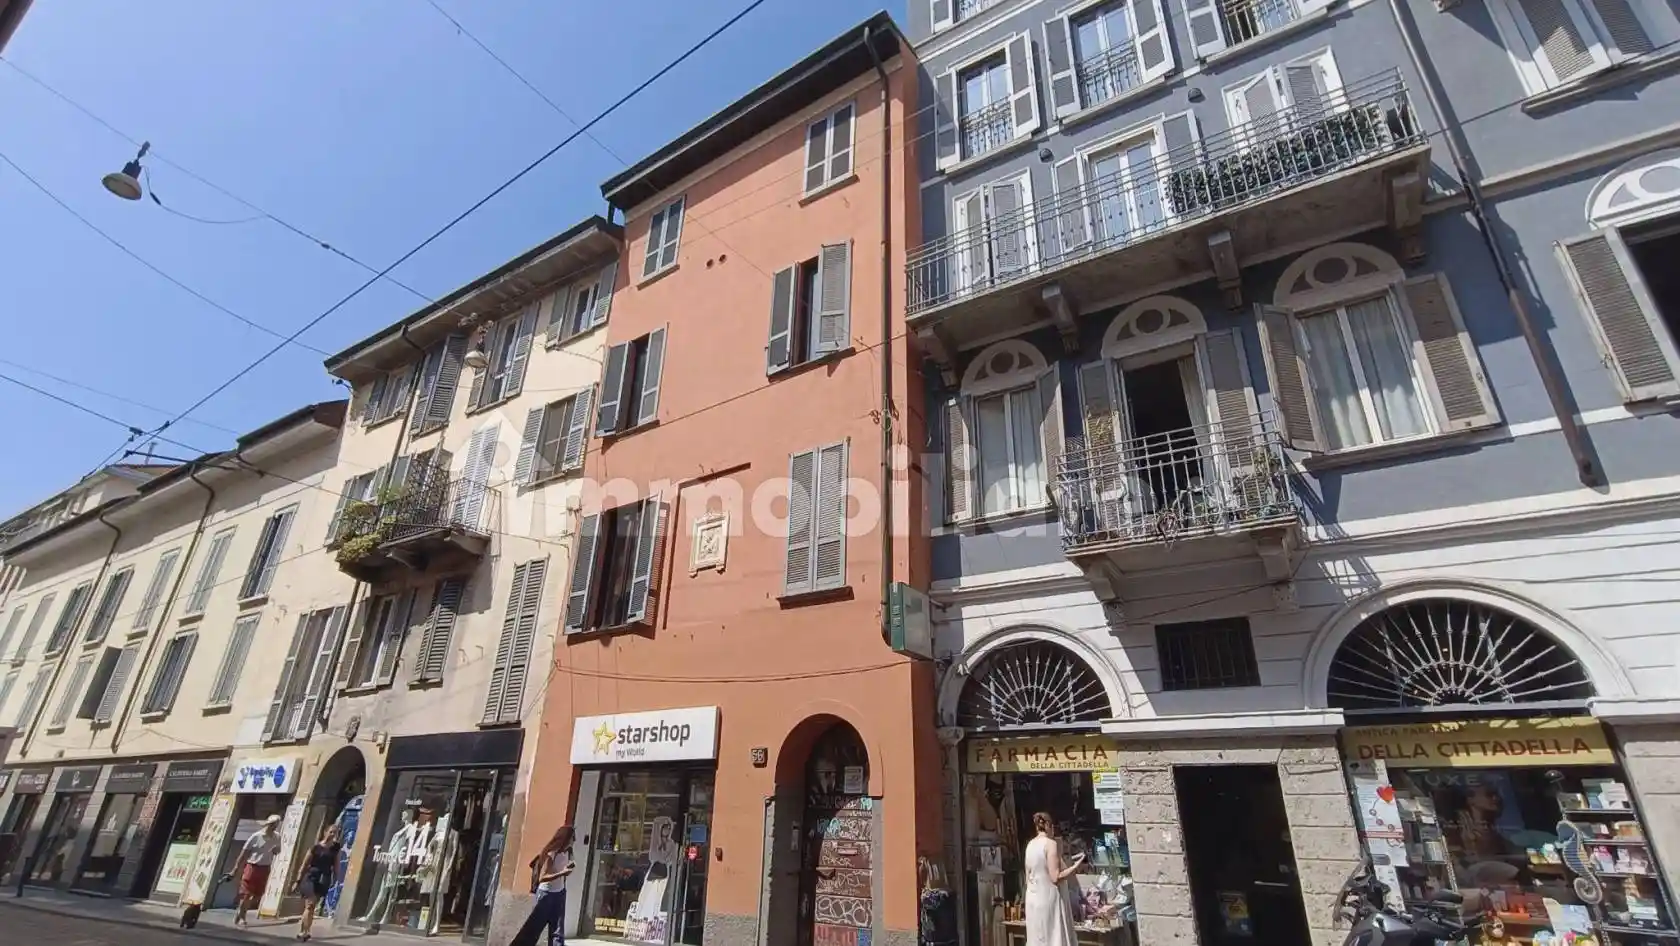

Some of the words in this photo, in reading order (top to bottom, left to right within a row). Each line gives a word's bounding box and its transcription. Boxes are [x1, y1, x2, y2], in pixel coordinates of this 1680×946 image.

[617, 720, 690, 747] starshop
[752, 749, 765, 761] 56
[976, 745, 1108, 762] FARMACIA
[1358, 743, 1430, 760] DELLA
[1437, 738, 1592, 757] CITTADELLA
[1059, 760, 1109, 769] CITTADELLA
